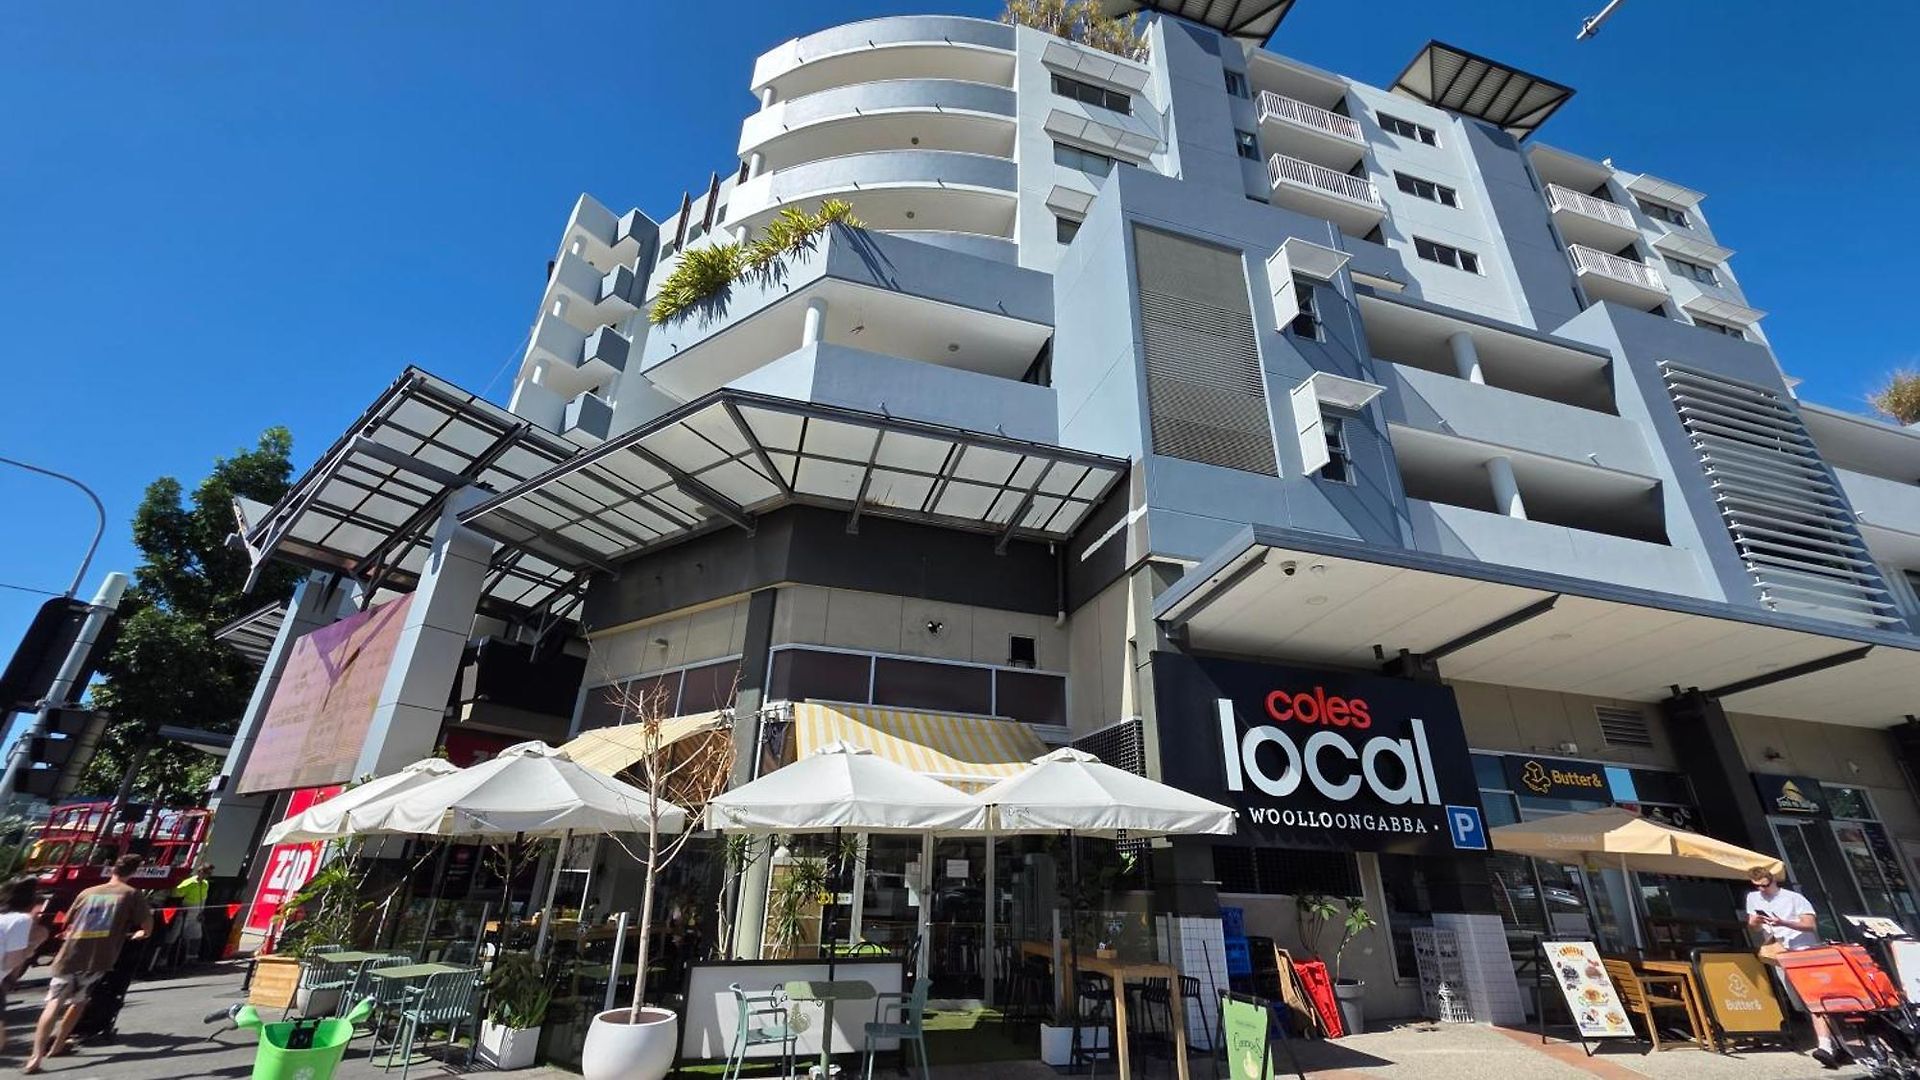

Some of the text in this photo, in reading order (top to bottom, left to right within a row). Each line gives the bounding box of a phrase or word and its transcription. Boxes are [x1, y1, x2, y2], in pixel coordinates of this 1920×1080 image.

[1265, 687, 1373, 730] coles
[1217, 698, 1442, 806] local
[1551, 769, 1603, 788] Butter&
[1249, 807, 1428, 834] WOOLLOONGABBA
[1454, 812, 1475, 842] P
